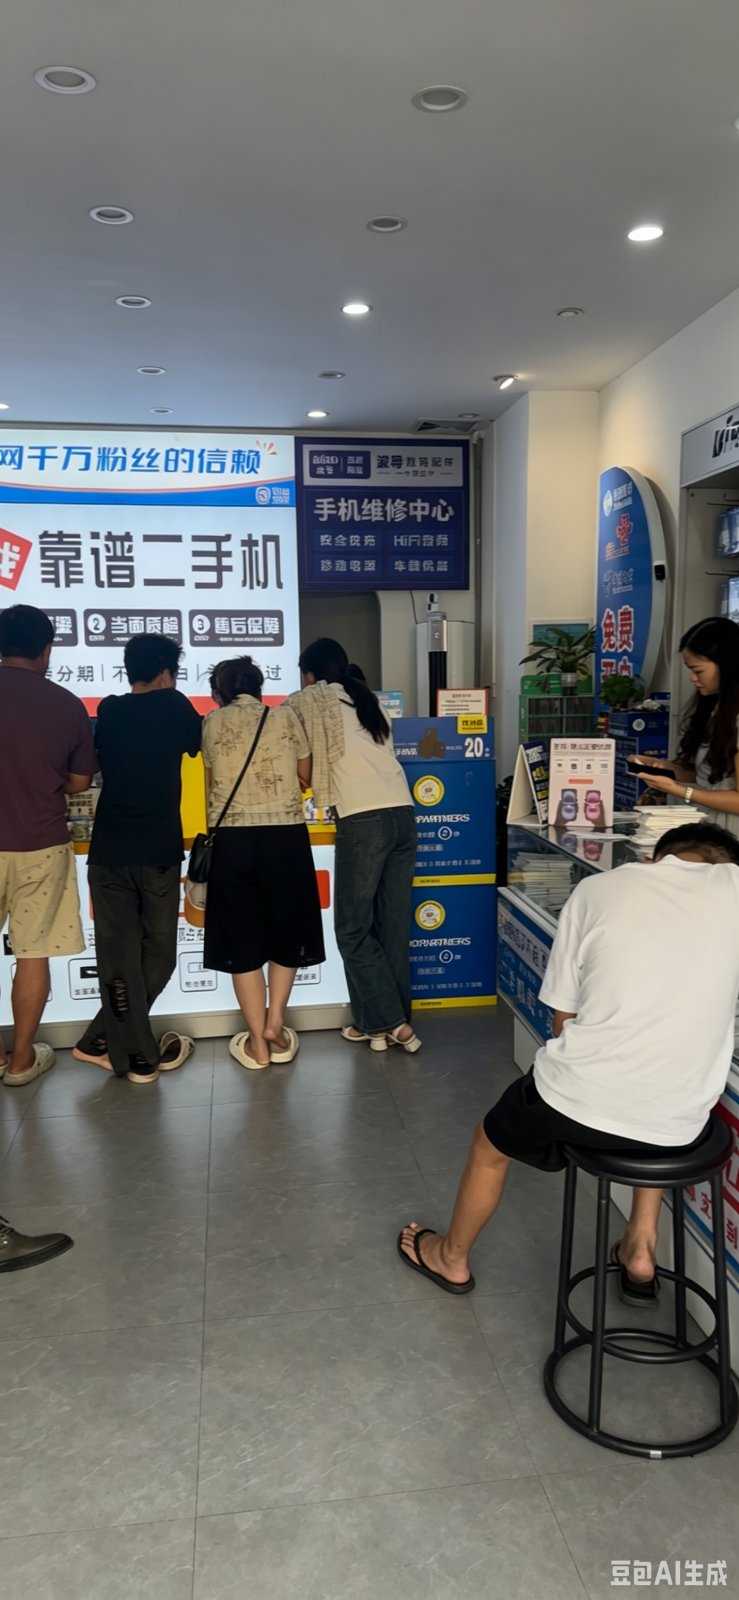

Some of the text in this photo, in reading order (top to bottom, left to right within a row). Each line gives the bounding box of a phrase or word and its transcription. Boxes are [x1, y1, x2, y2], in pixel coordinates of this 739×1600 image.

[0, 445, 261, 475] 网千万粉丝的信赖
[313, 497, 455, 522] 手机维修中心
[38, 530, 284, 590] 靠谱二手机
[464, 737, 484, 758] 20
